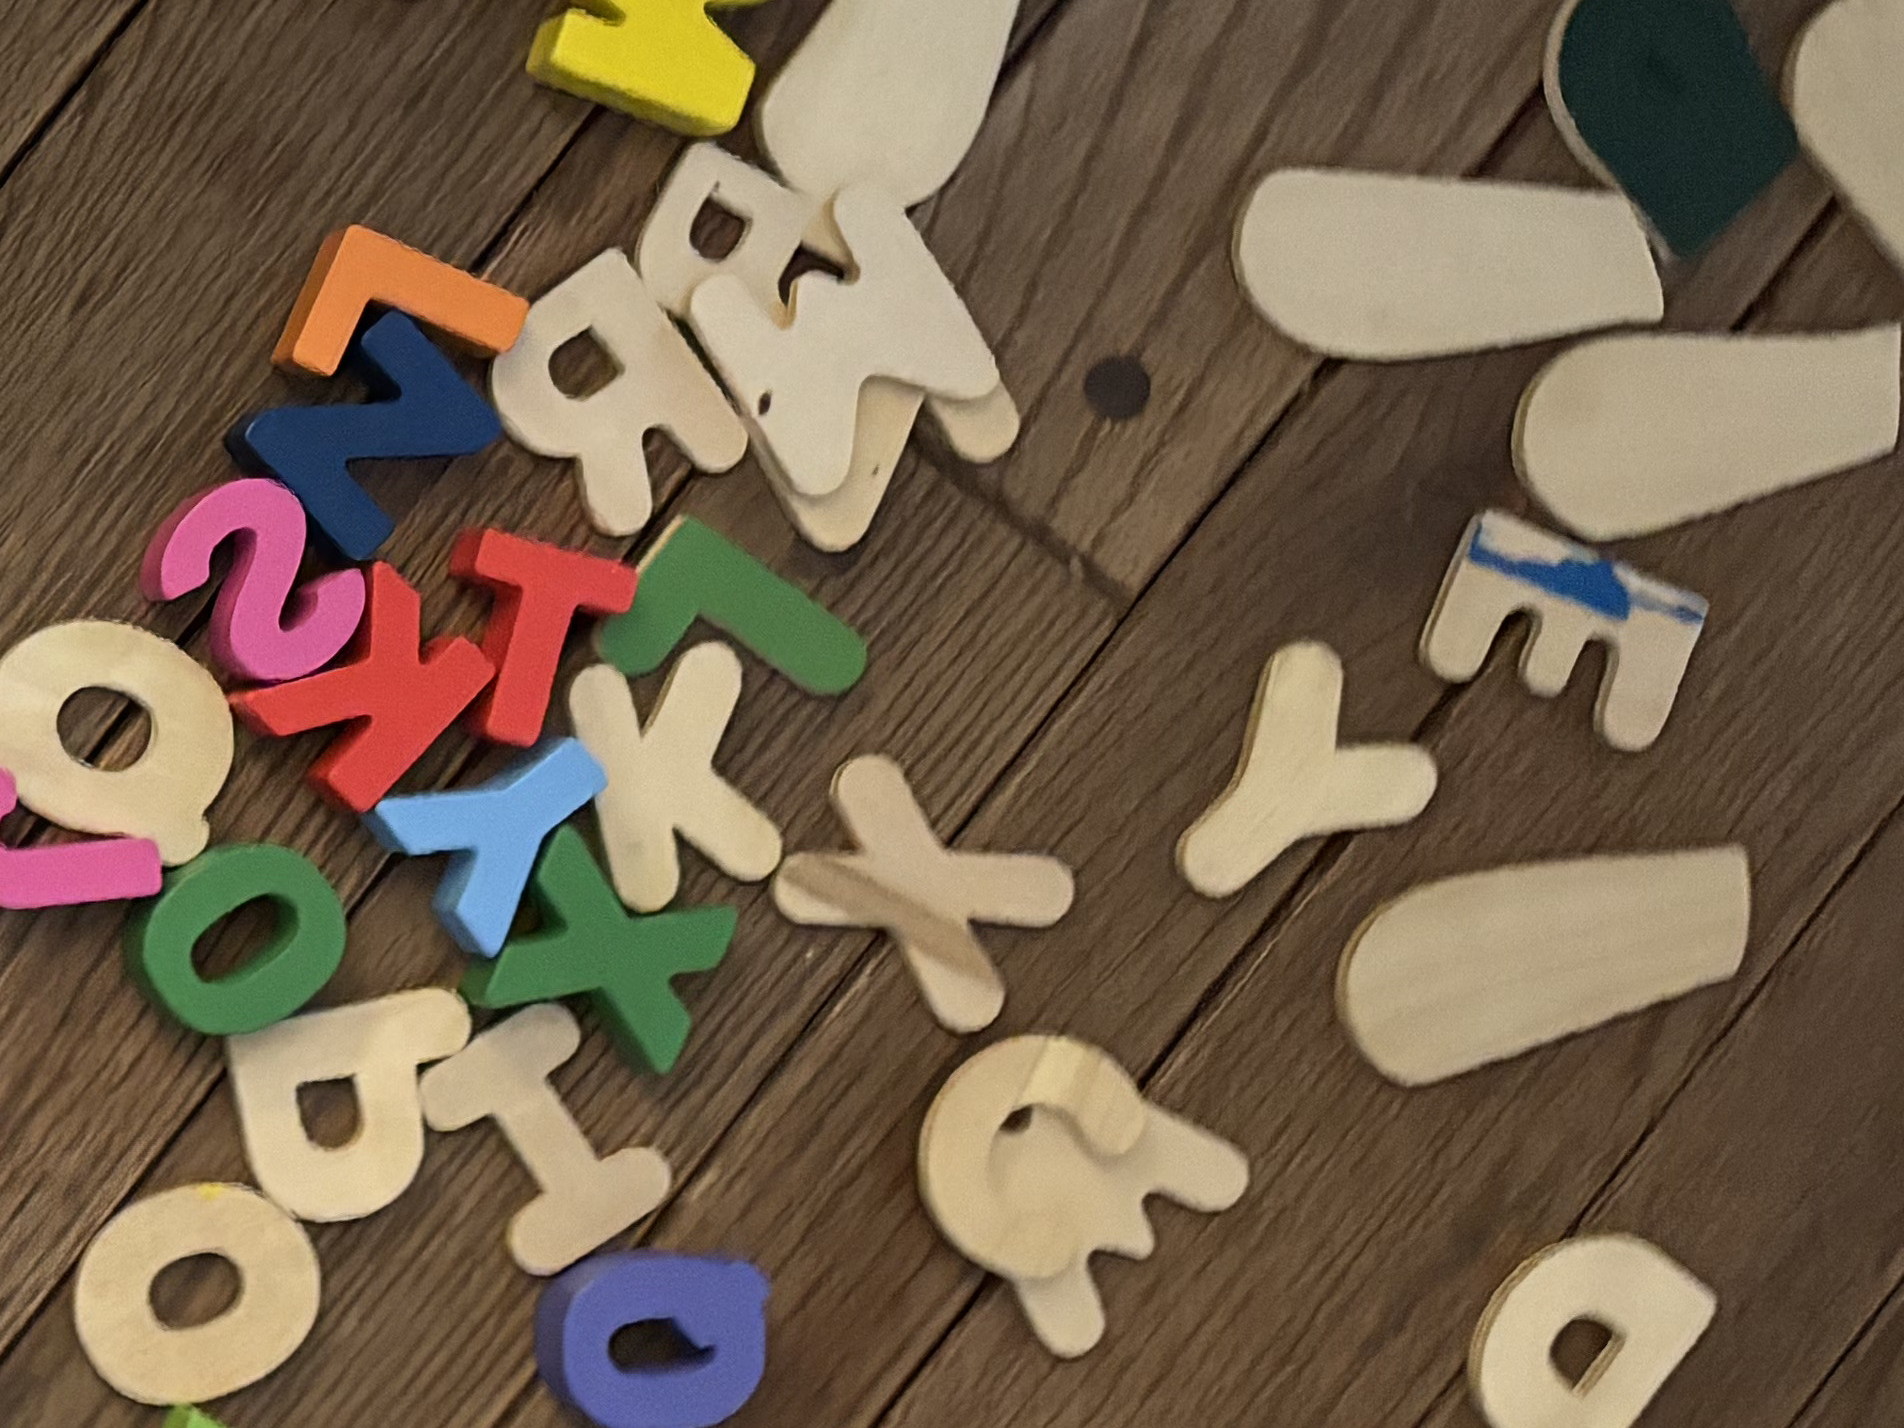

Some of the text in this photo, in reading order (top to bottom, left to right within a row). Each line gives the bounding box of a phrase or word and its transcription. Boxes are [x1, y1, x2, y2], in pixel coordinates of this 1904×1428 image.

[271, 224, 531, 375] L
[228, 560, 494, 813] K
[450, 527, 638, 746] T
[365, 736, 607, 959] Y
[569, 641, 783, 913] K
[1177, 640, 1438, 898] Y
[125, 842, 347, 1035] O
[458, 826, 737, 1073] X
[773, 755, 1075, 1032] X
[75, 1182, 322, 1406] O
